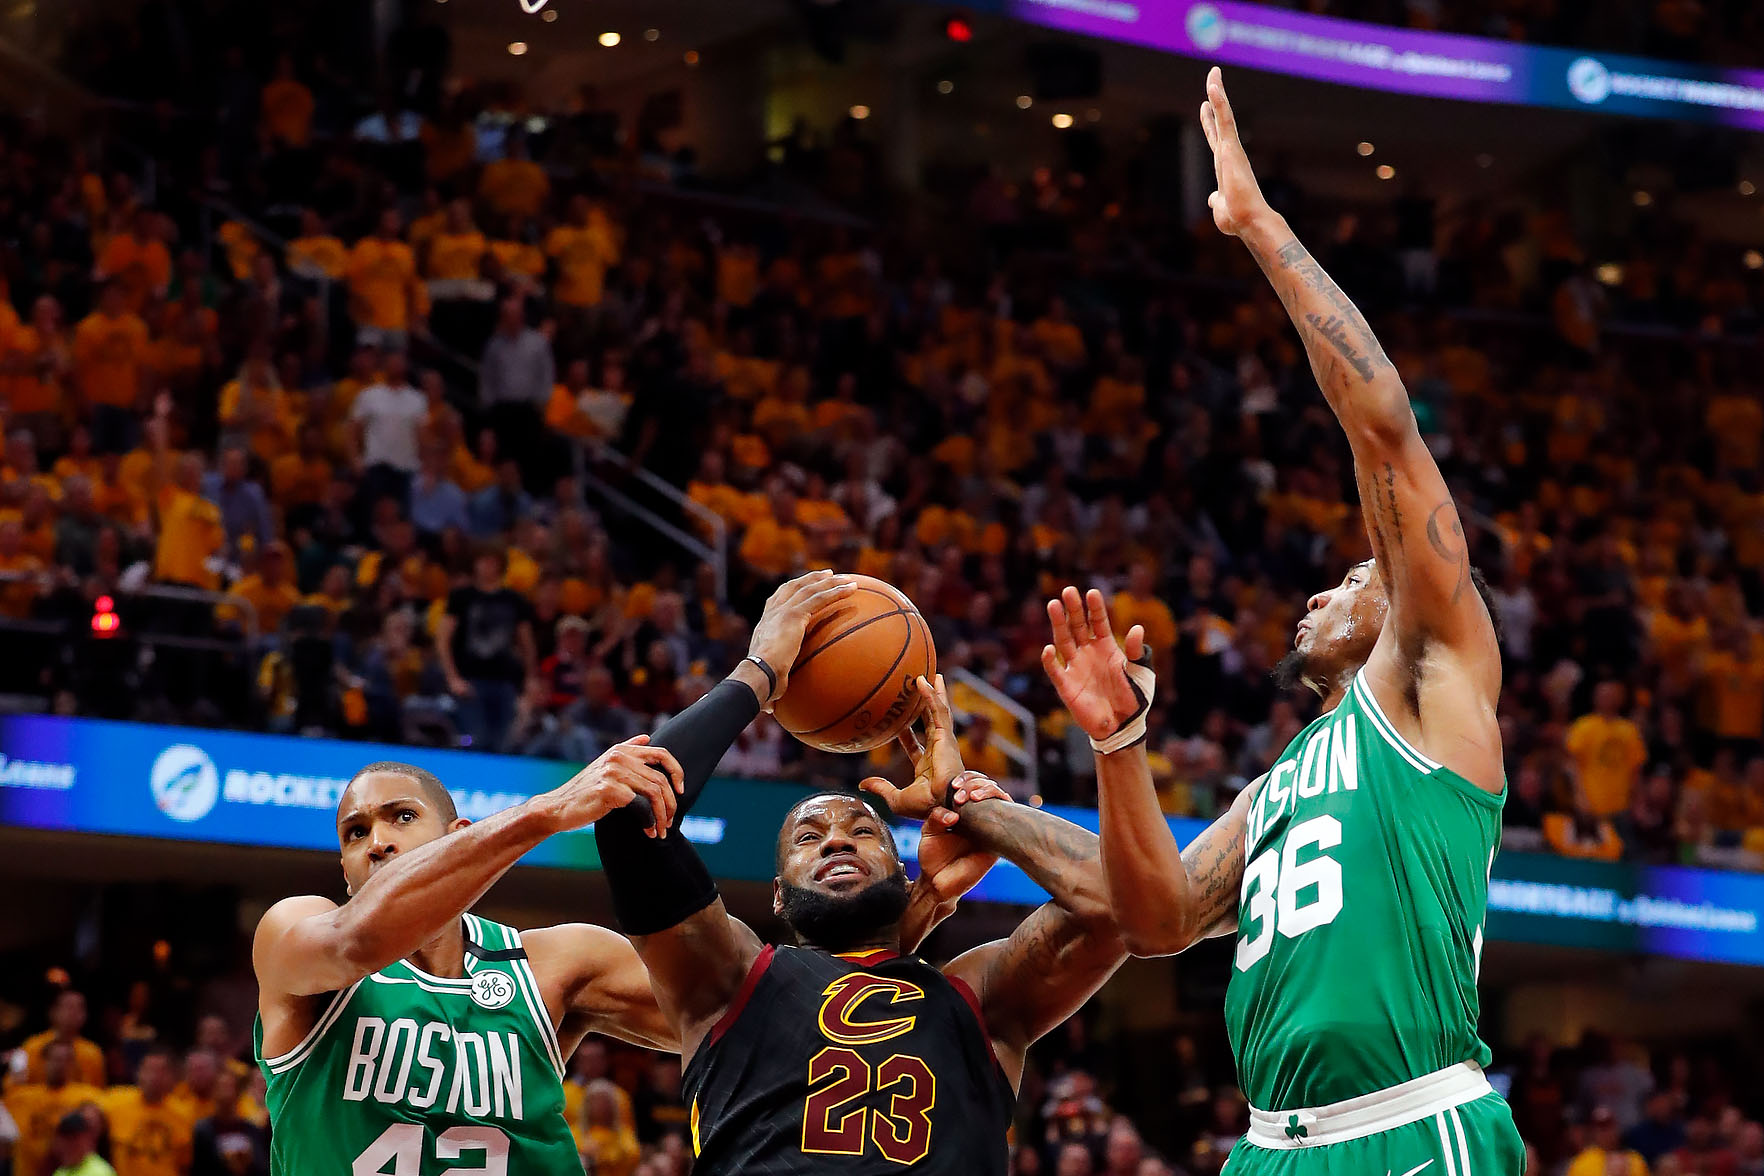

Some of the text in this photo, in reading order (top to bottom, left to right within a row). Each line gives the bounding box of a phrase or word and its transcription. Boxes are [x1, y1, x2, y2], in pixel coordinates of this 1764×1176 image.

[1235, 813, 1344, 973] 36
[343, 1016, 523, 1121] BOSTON
[801, 1046, 936, 1166] 23
